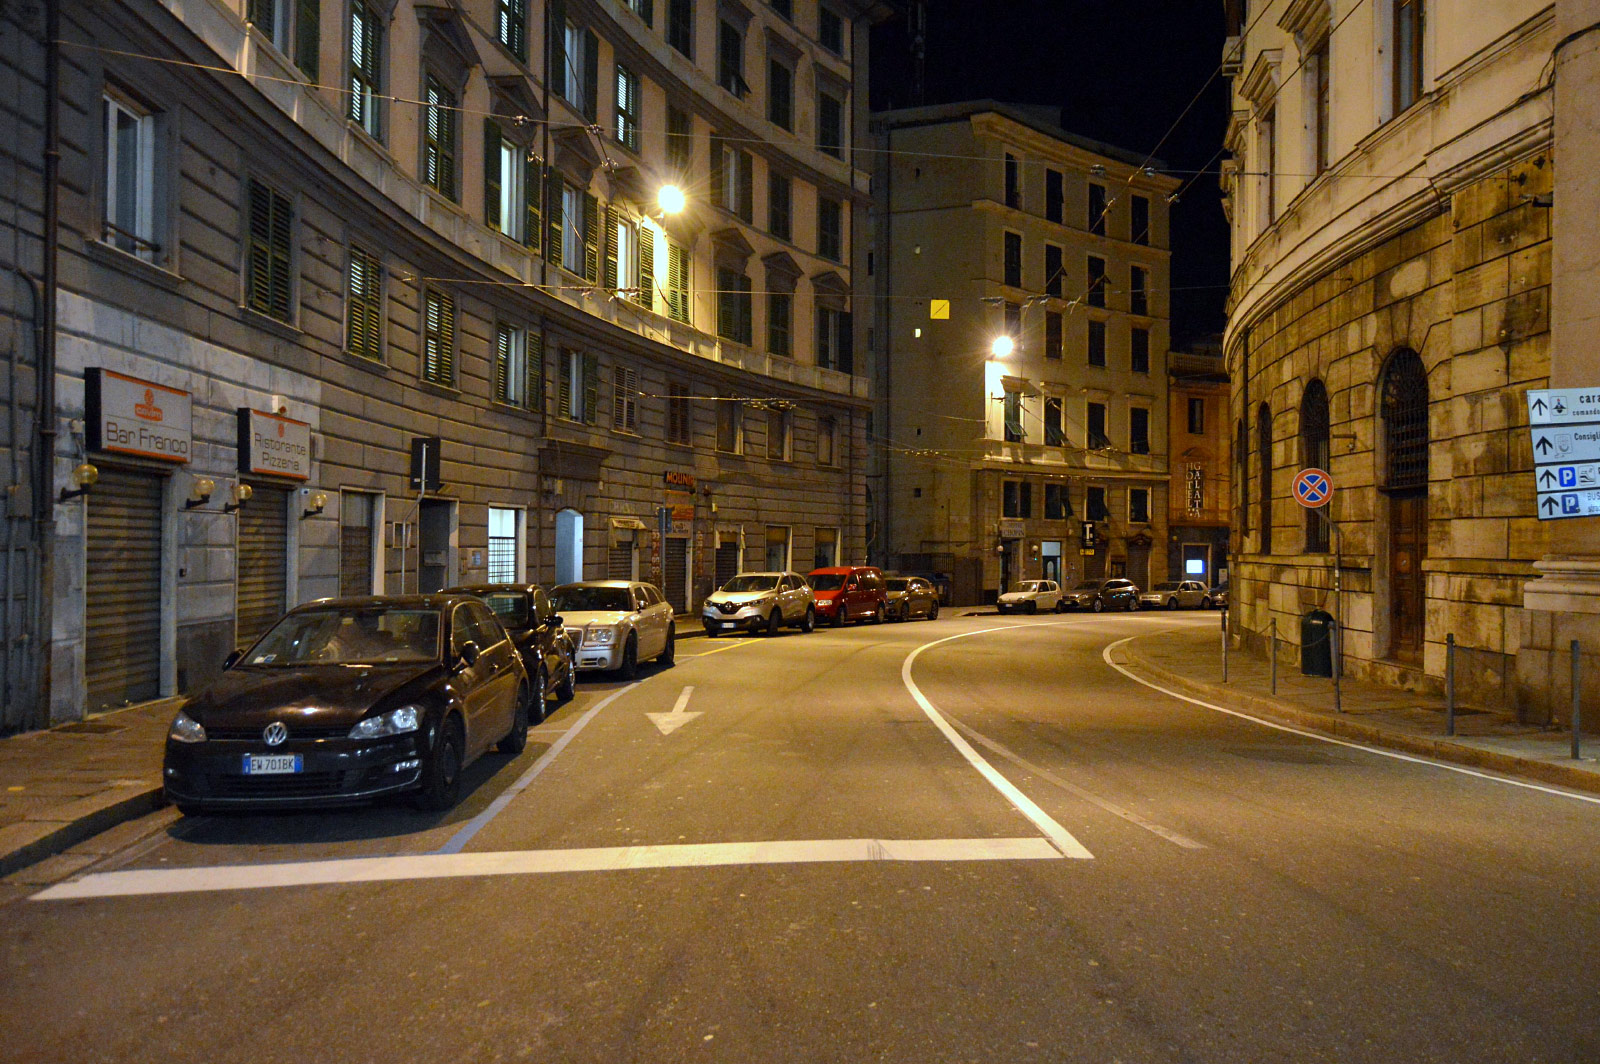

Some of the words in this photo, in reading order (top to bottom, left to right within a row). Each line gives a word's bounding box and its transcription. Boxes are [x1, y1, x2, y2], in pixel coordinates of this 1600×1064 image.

[106, 421, 136, 444] Bar
[139, 427, 187, 454] Franco
[254, 432, 306, 456] Ristorante
[262, 451, 300, 471] Pizzeria
